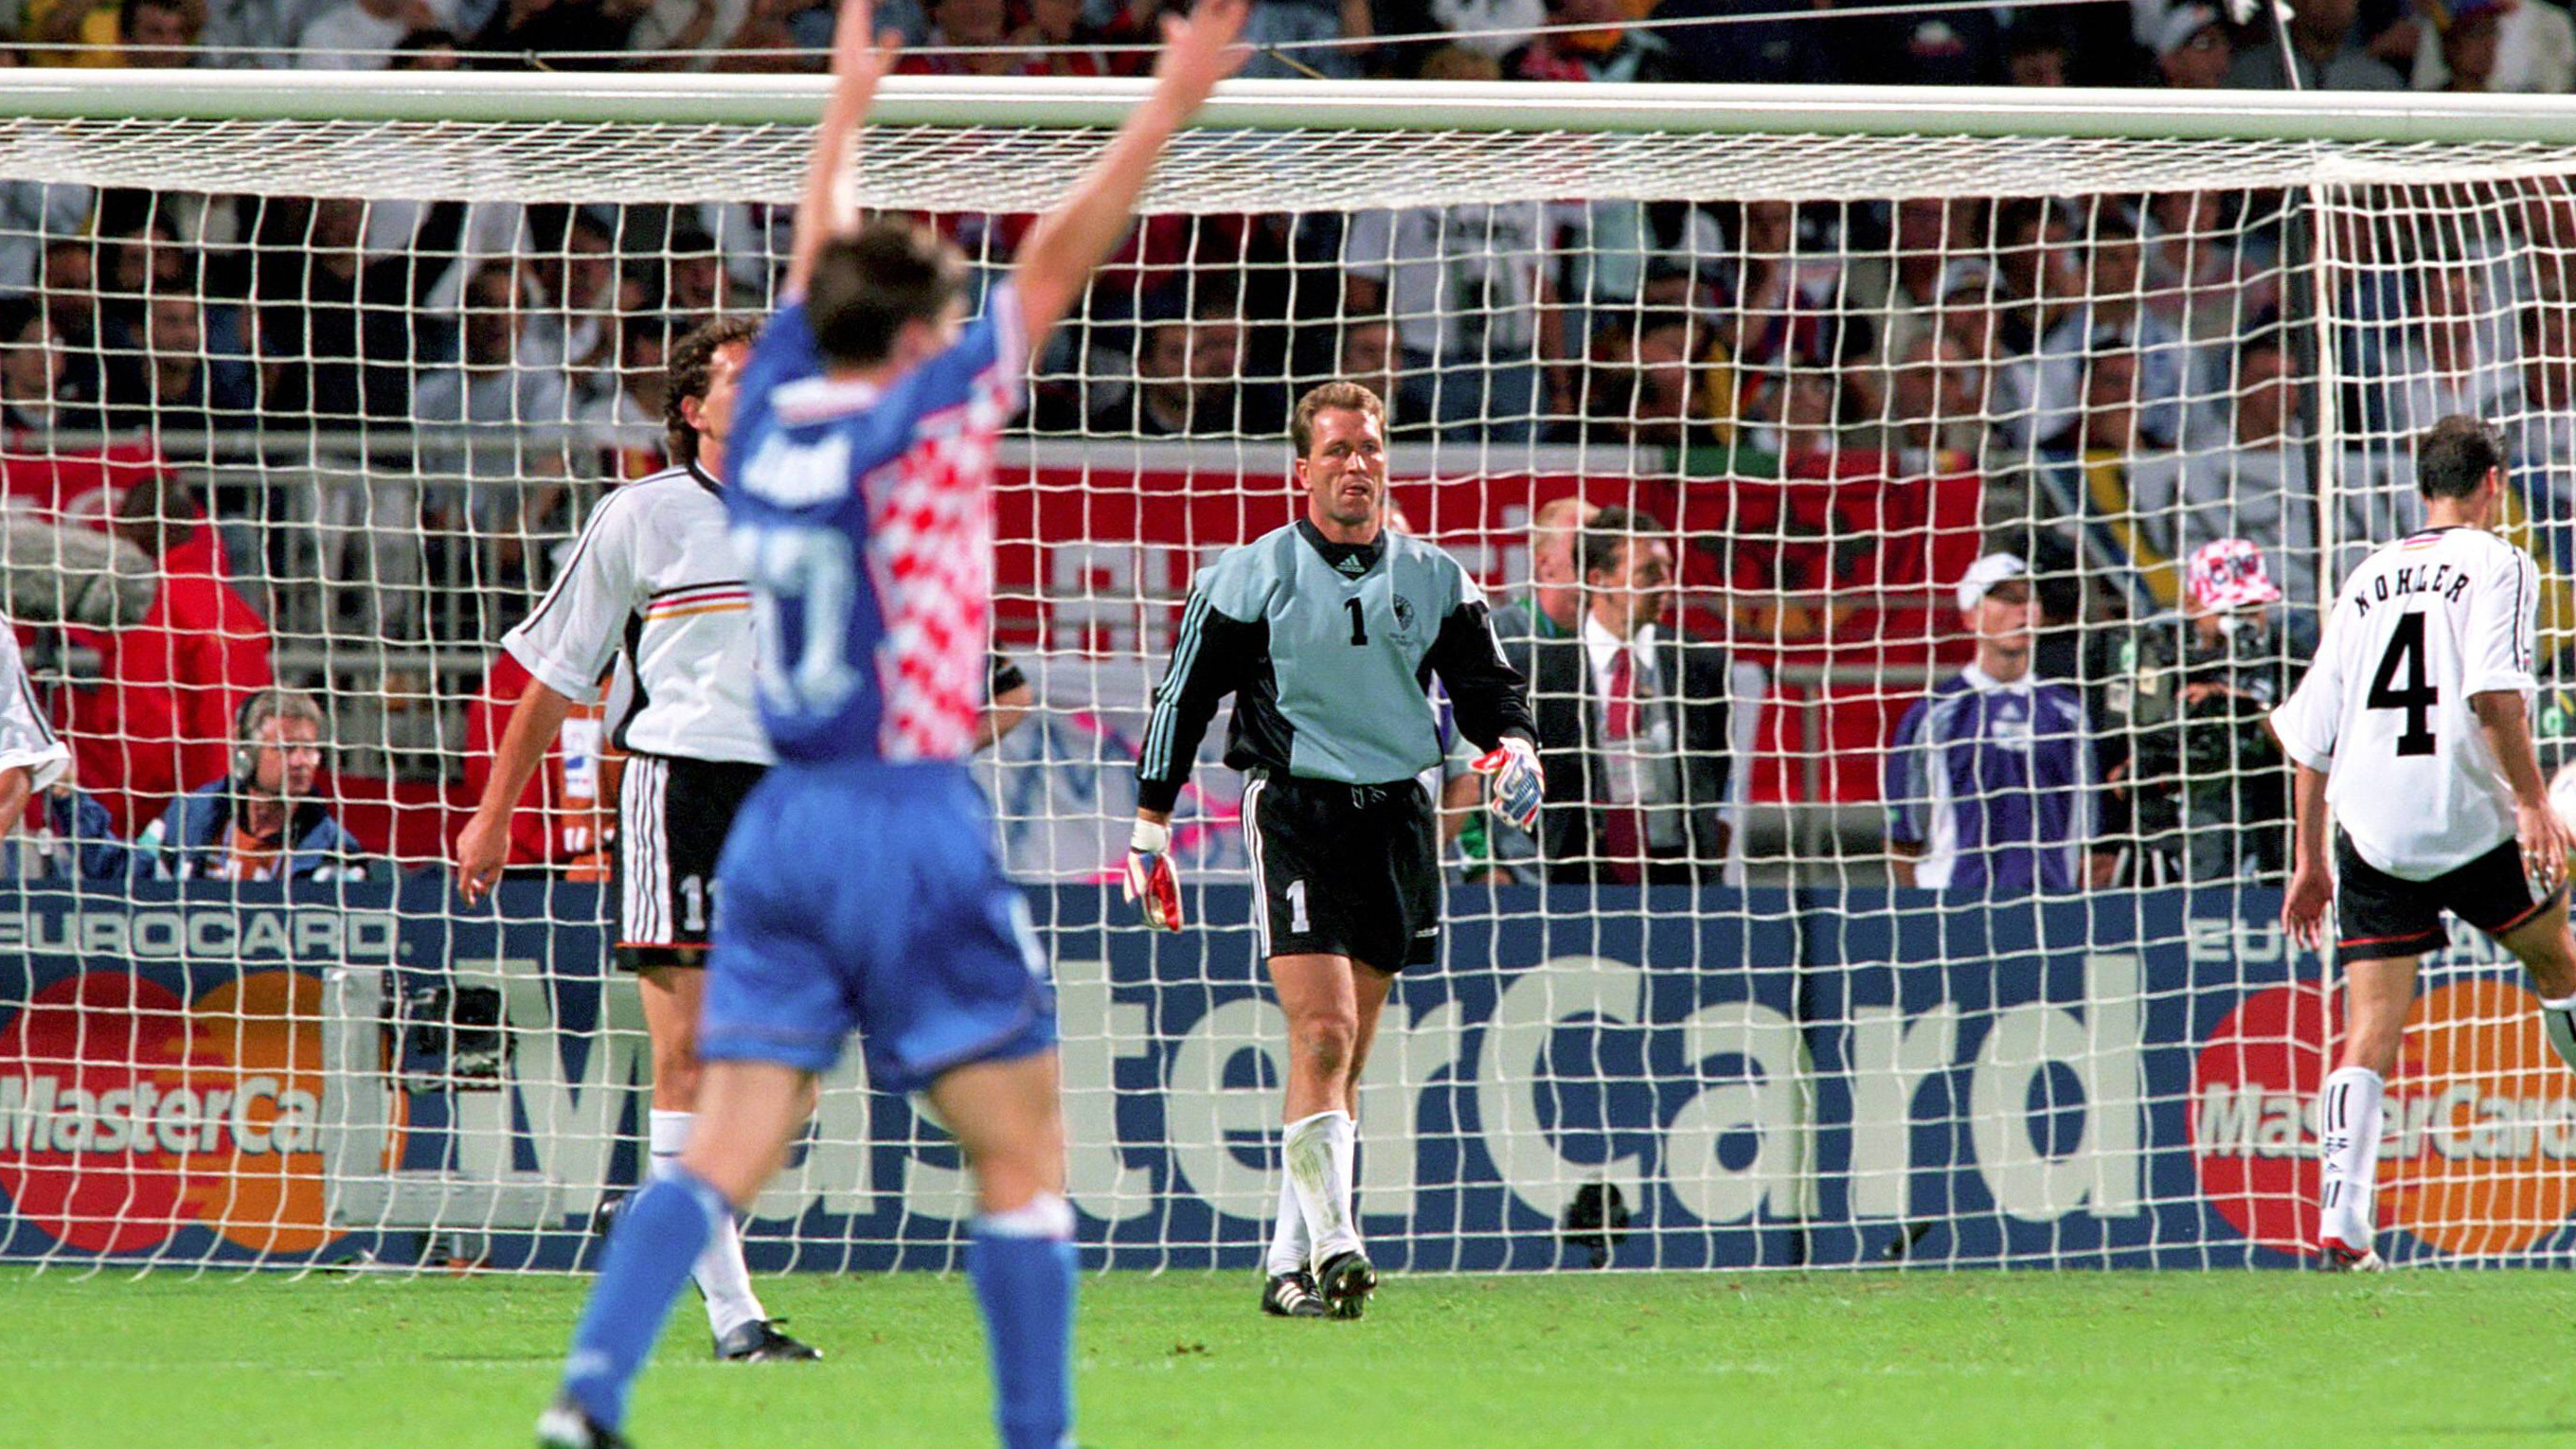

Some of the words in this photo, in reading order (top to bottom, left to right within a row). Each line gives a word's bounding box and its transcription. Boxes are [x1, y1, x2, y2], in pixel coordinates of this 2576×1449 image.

[2354, 564, 2470, 617] KOHLER
[1344, 597, 1368, 646] 1
[2367, 611, 2439, 758] 4
[1286, 879, 1311, 934] 1
[0, 1076, 393, 1154] MasterCa
